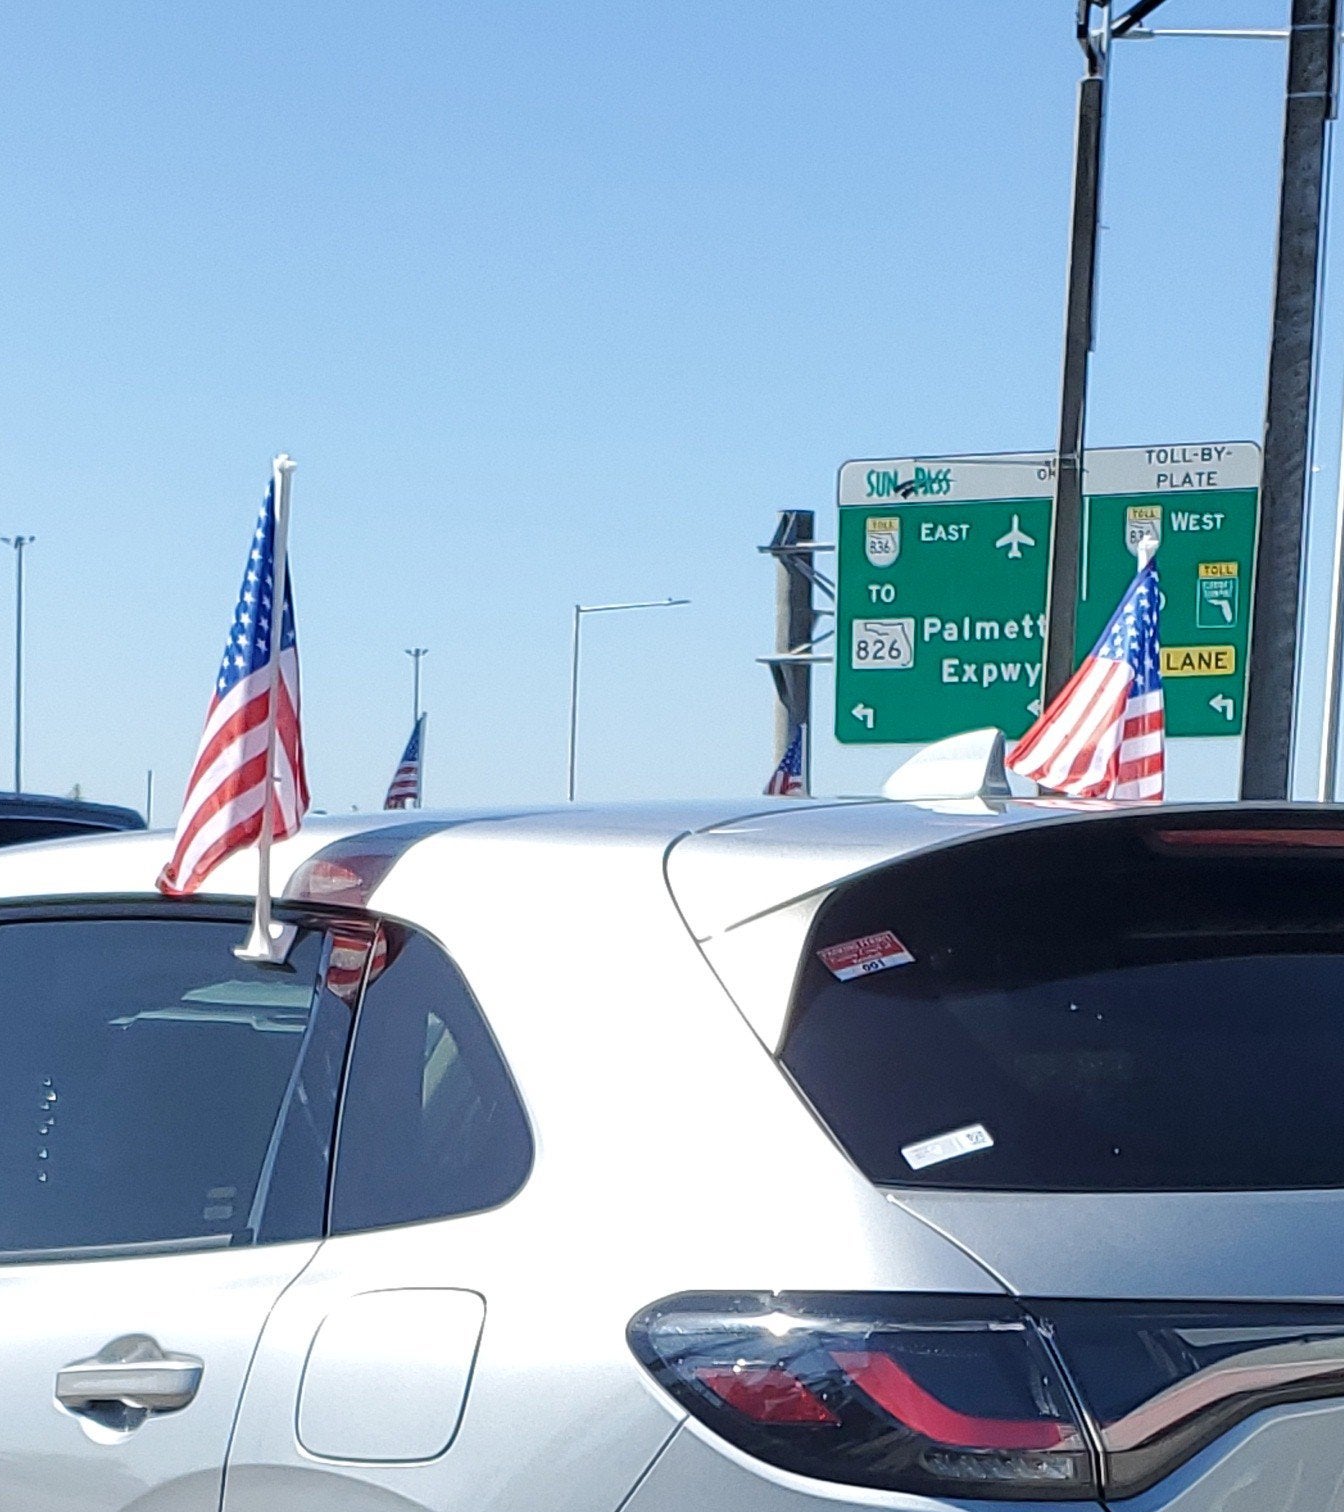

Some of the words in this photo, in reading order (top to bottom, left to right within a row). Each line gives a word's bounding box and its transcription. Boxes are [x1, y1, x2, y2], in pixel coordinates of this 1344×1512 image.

[1146, 447, 1233, 465] TOLL-BY-
[1156, 470, 1218, 488] PLATE
[1132, 507, 1156, 519] TOLL
[1171, 510, 1225, 531] WEST
[869, 538, 890, 555] 836
[920, 521, 970, 542] EAST
[1204, 563, 1234, 576] TOLL
[868, 582, 897, 604] TO
[856, 638, 902, 660] 826
[923, 612, 1047, 643] Palmett
[1166, 650, 1228, 672] LANE
[942, 657, 1042, 688] Expwy
